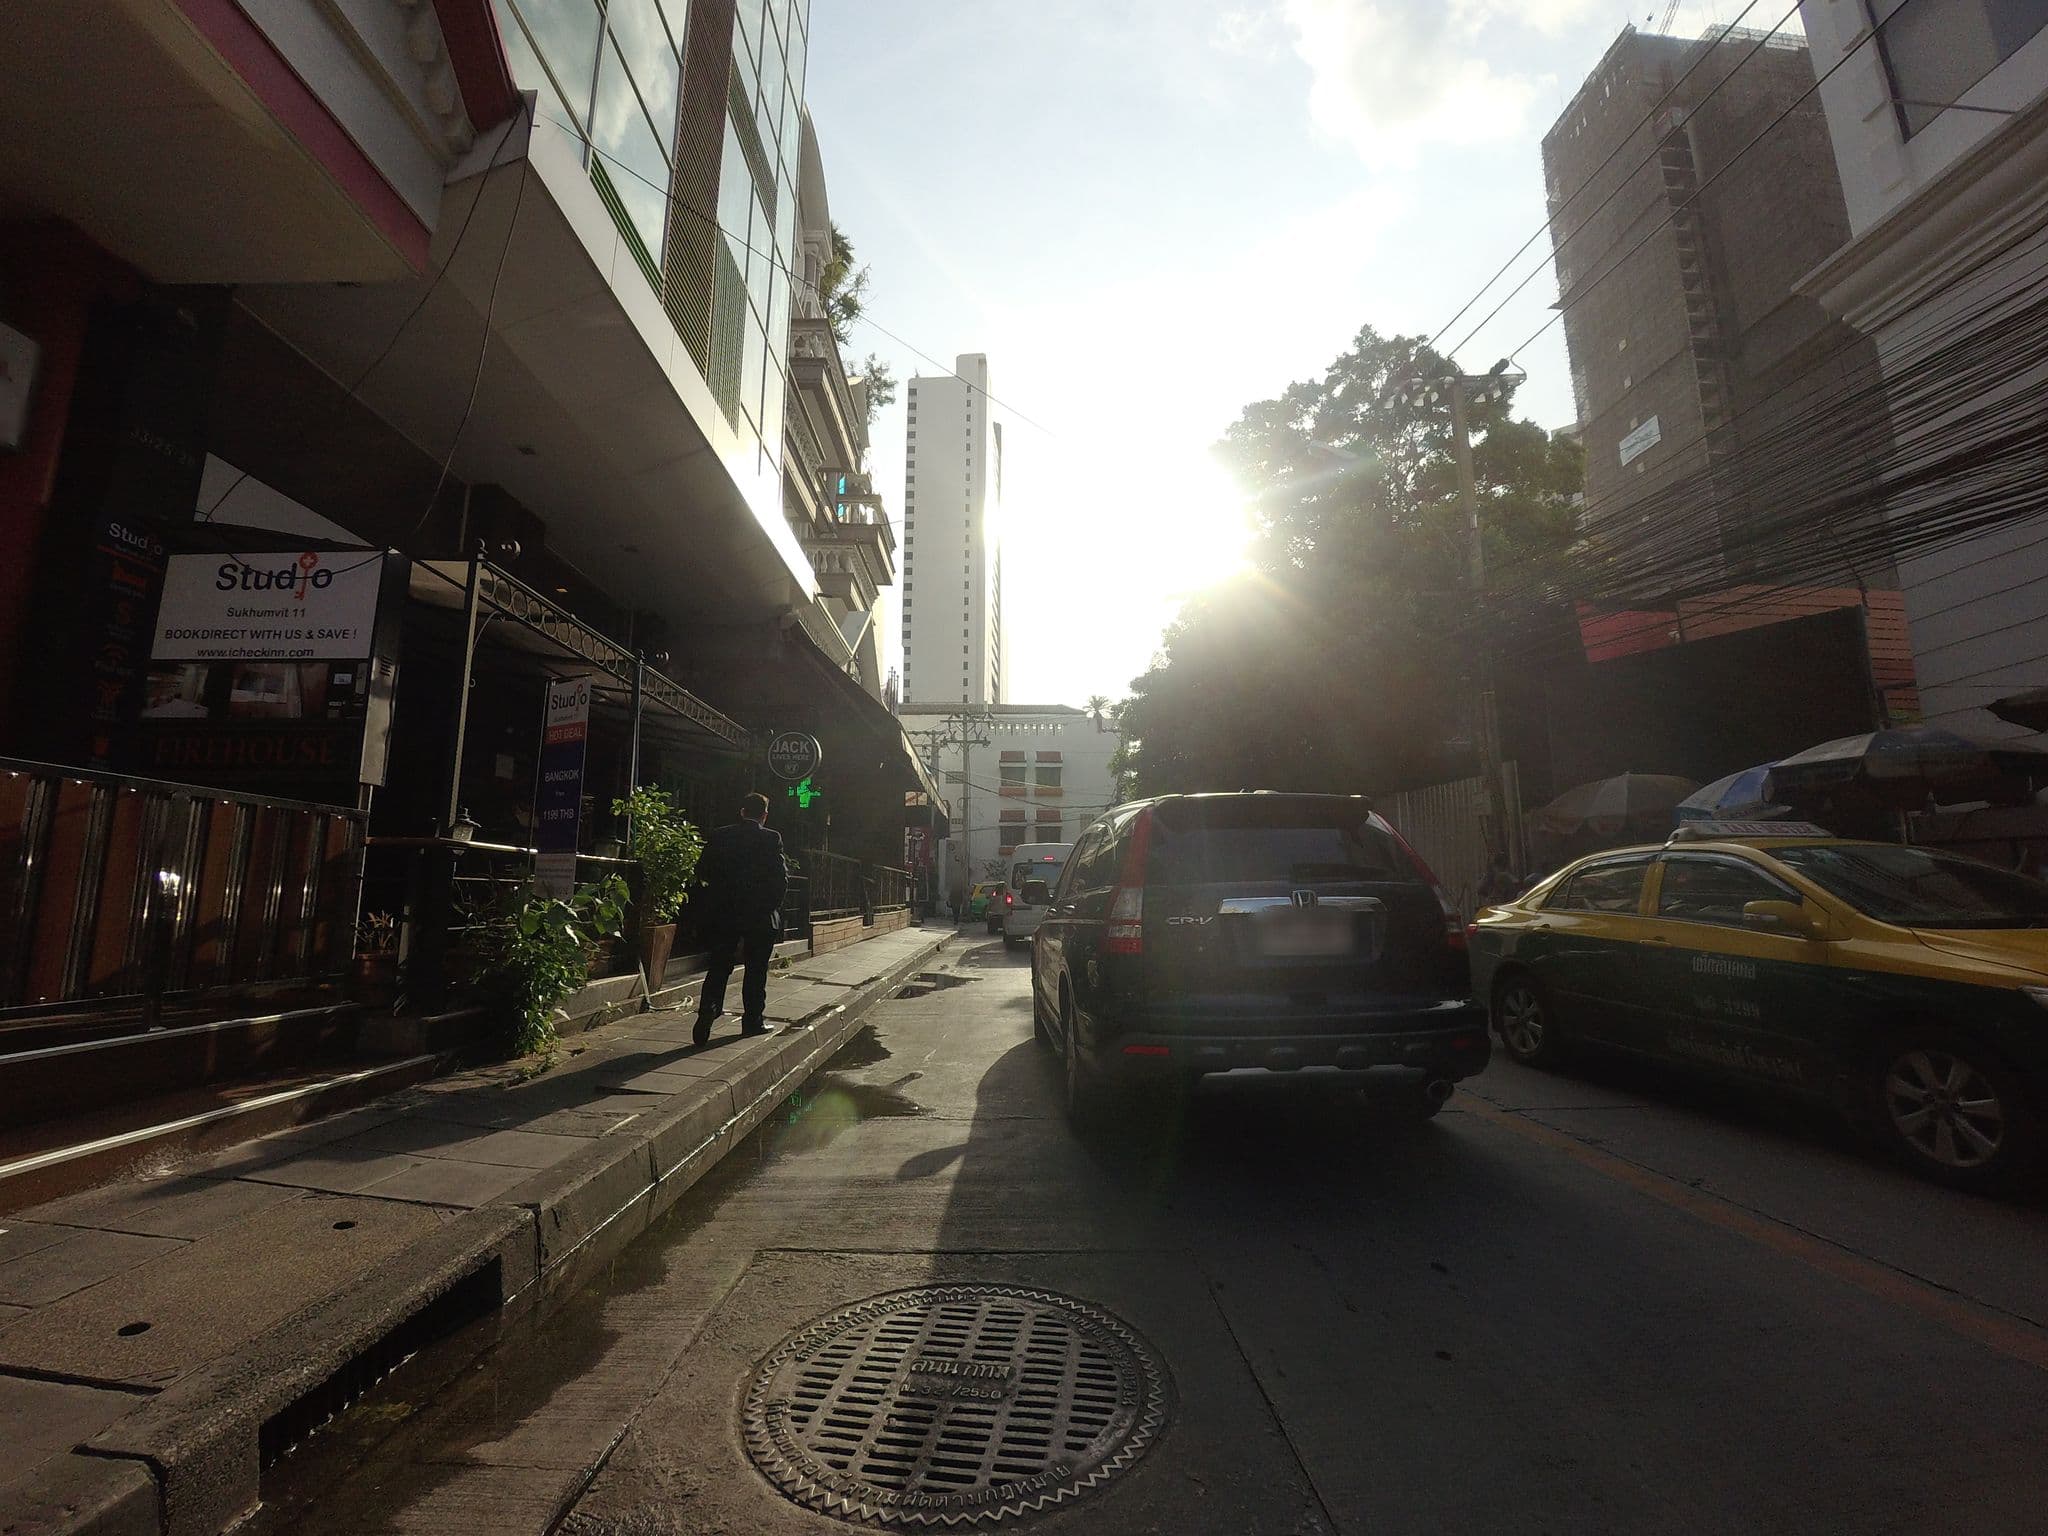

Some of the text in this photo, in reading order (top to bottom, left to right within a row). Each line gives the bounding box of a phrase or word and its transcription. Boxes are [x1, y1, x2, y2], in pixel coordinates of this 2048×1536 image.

[227, 606, 306, 618] Sukhumvit 11
[250, 629, 281, 640] WITH
[284, 628, 302, 640] US
[305, 628, 314, 640] &
[316, 627, 350, 639] SAVE
[197, 647, 314, 659] www.icheckinn.com
[772, 741, 811, 754] JACK
[544, 769, 580, 783] BANGKOK
